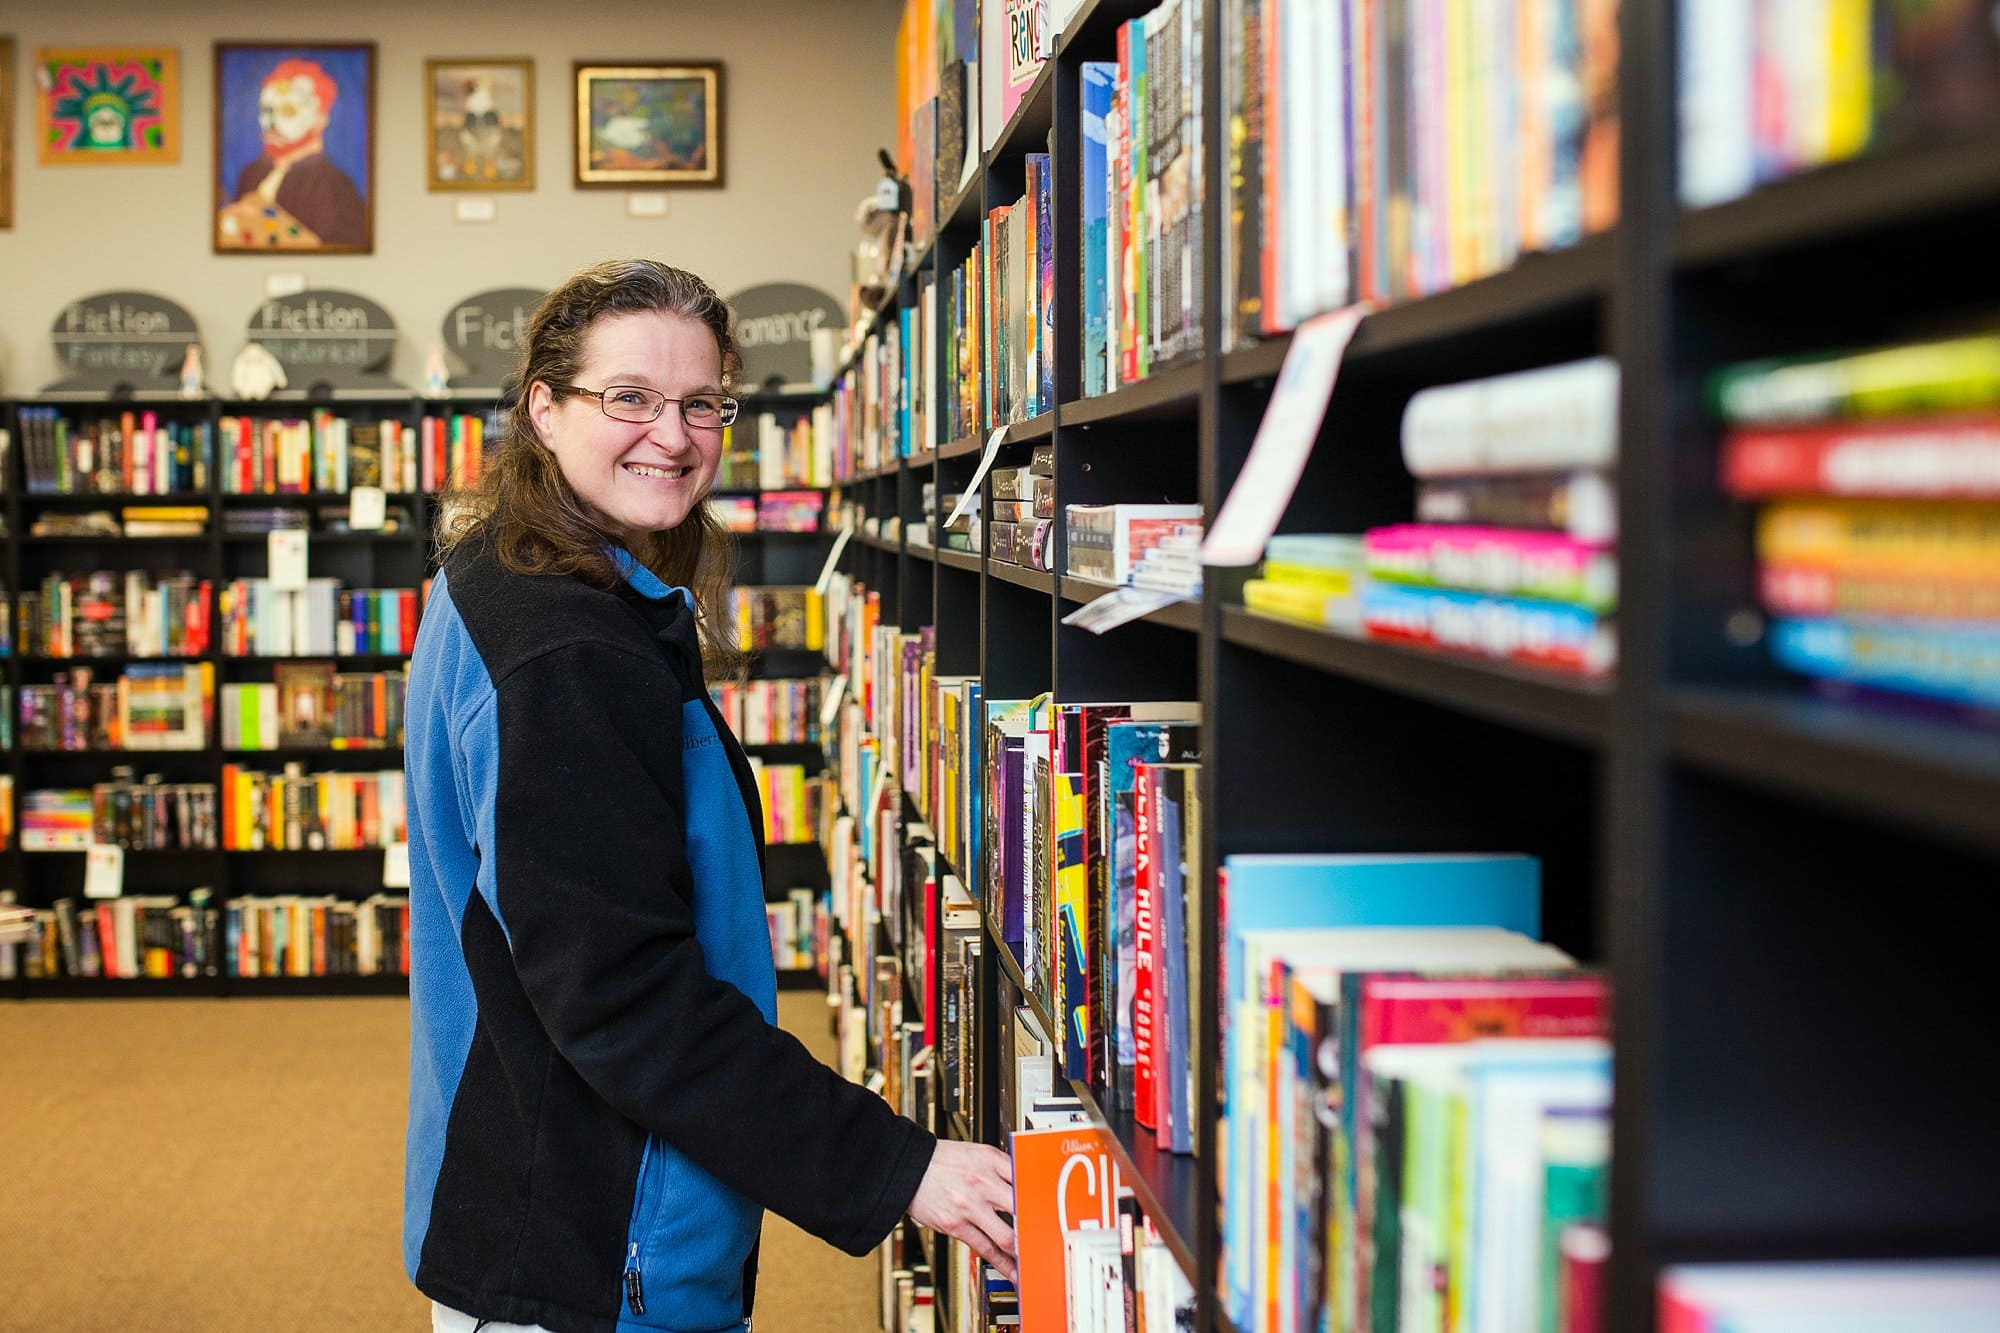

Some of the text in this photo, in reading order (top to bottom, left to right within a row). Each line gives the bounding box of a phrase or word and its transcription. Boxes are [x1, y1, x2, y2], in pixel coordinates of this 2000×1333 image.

[66, 301, 170, 335] Fiction
[262, 297, 368, 332] Fiction
[455, 306, 530, 350] Fict
[737, 308, 827, 348] omance
